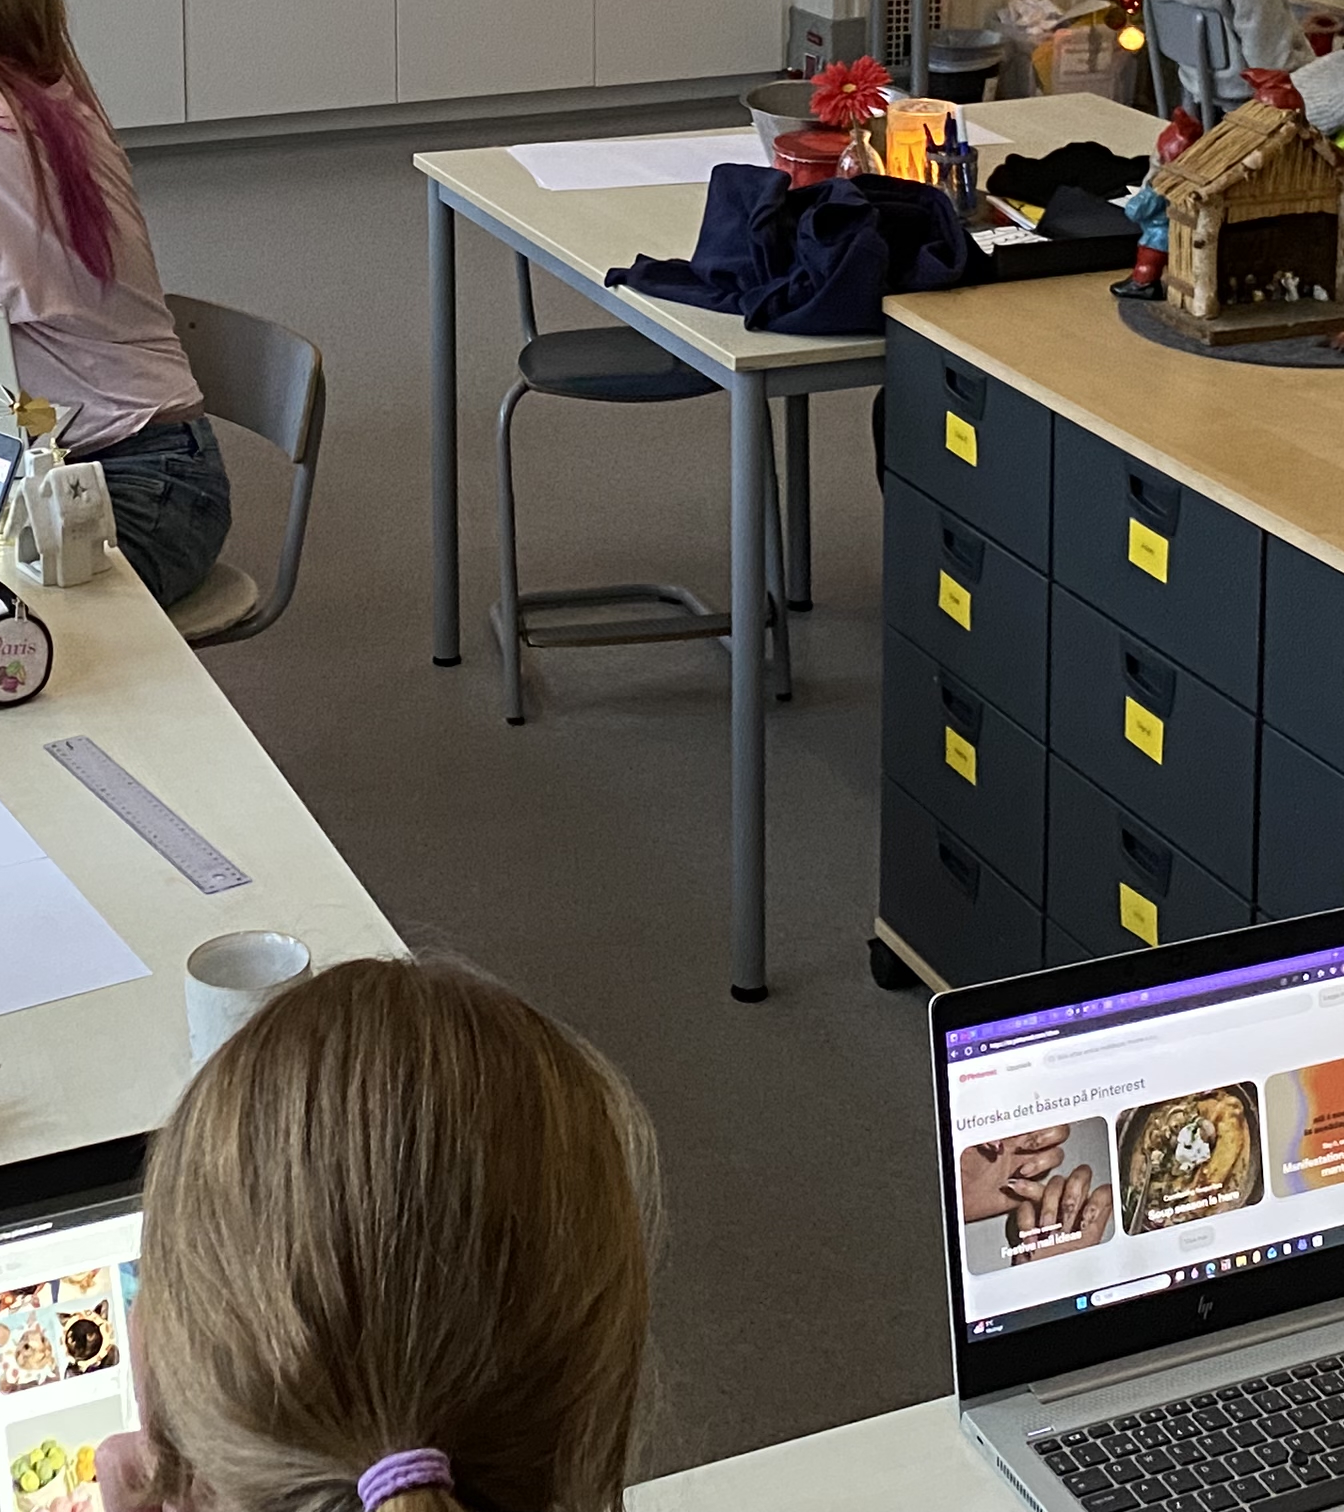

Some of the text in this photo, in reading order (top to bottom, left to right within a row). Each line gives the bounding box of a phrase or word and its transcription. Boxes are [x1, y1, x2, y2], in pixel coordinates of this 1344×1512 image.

[955, 1078, 1146, 1132] Utforska det bästa på Pinterest
[1282, 1150, 1344, 1176] Manifestation
[1147, 1189, 1240, 1222] Soup season is here
[1001, 1229, 1083, 1259] Festive nail ideas
